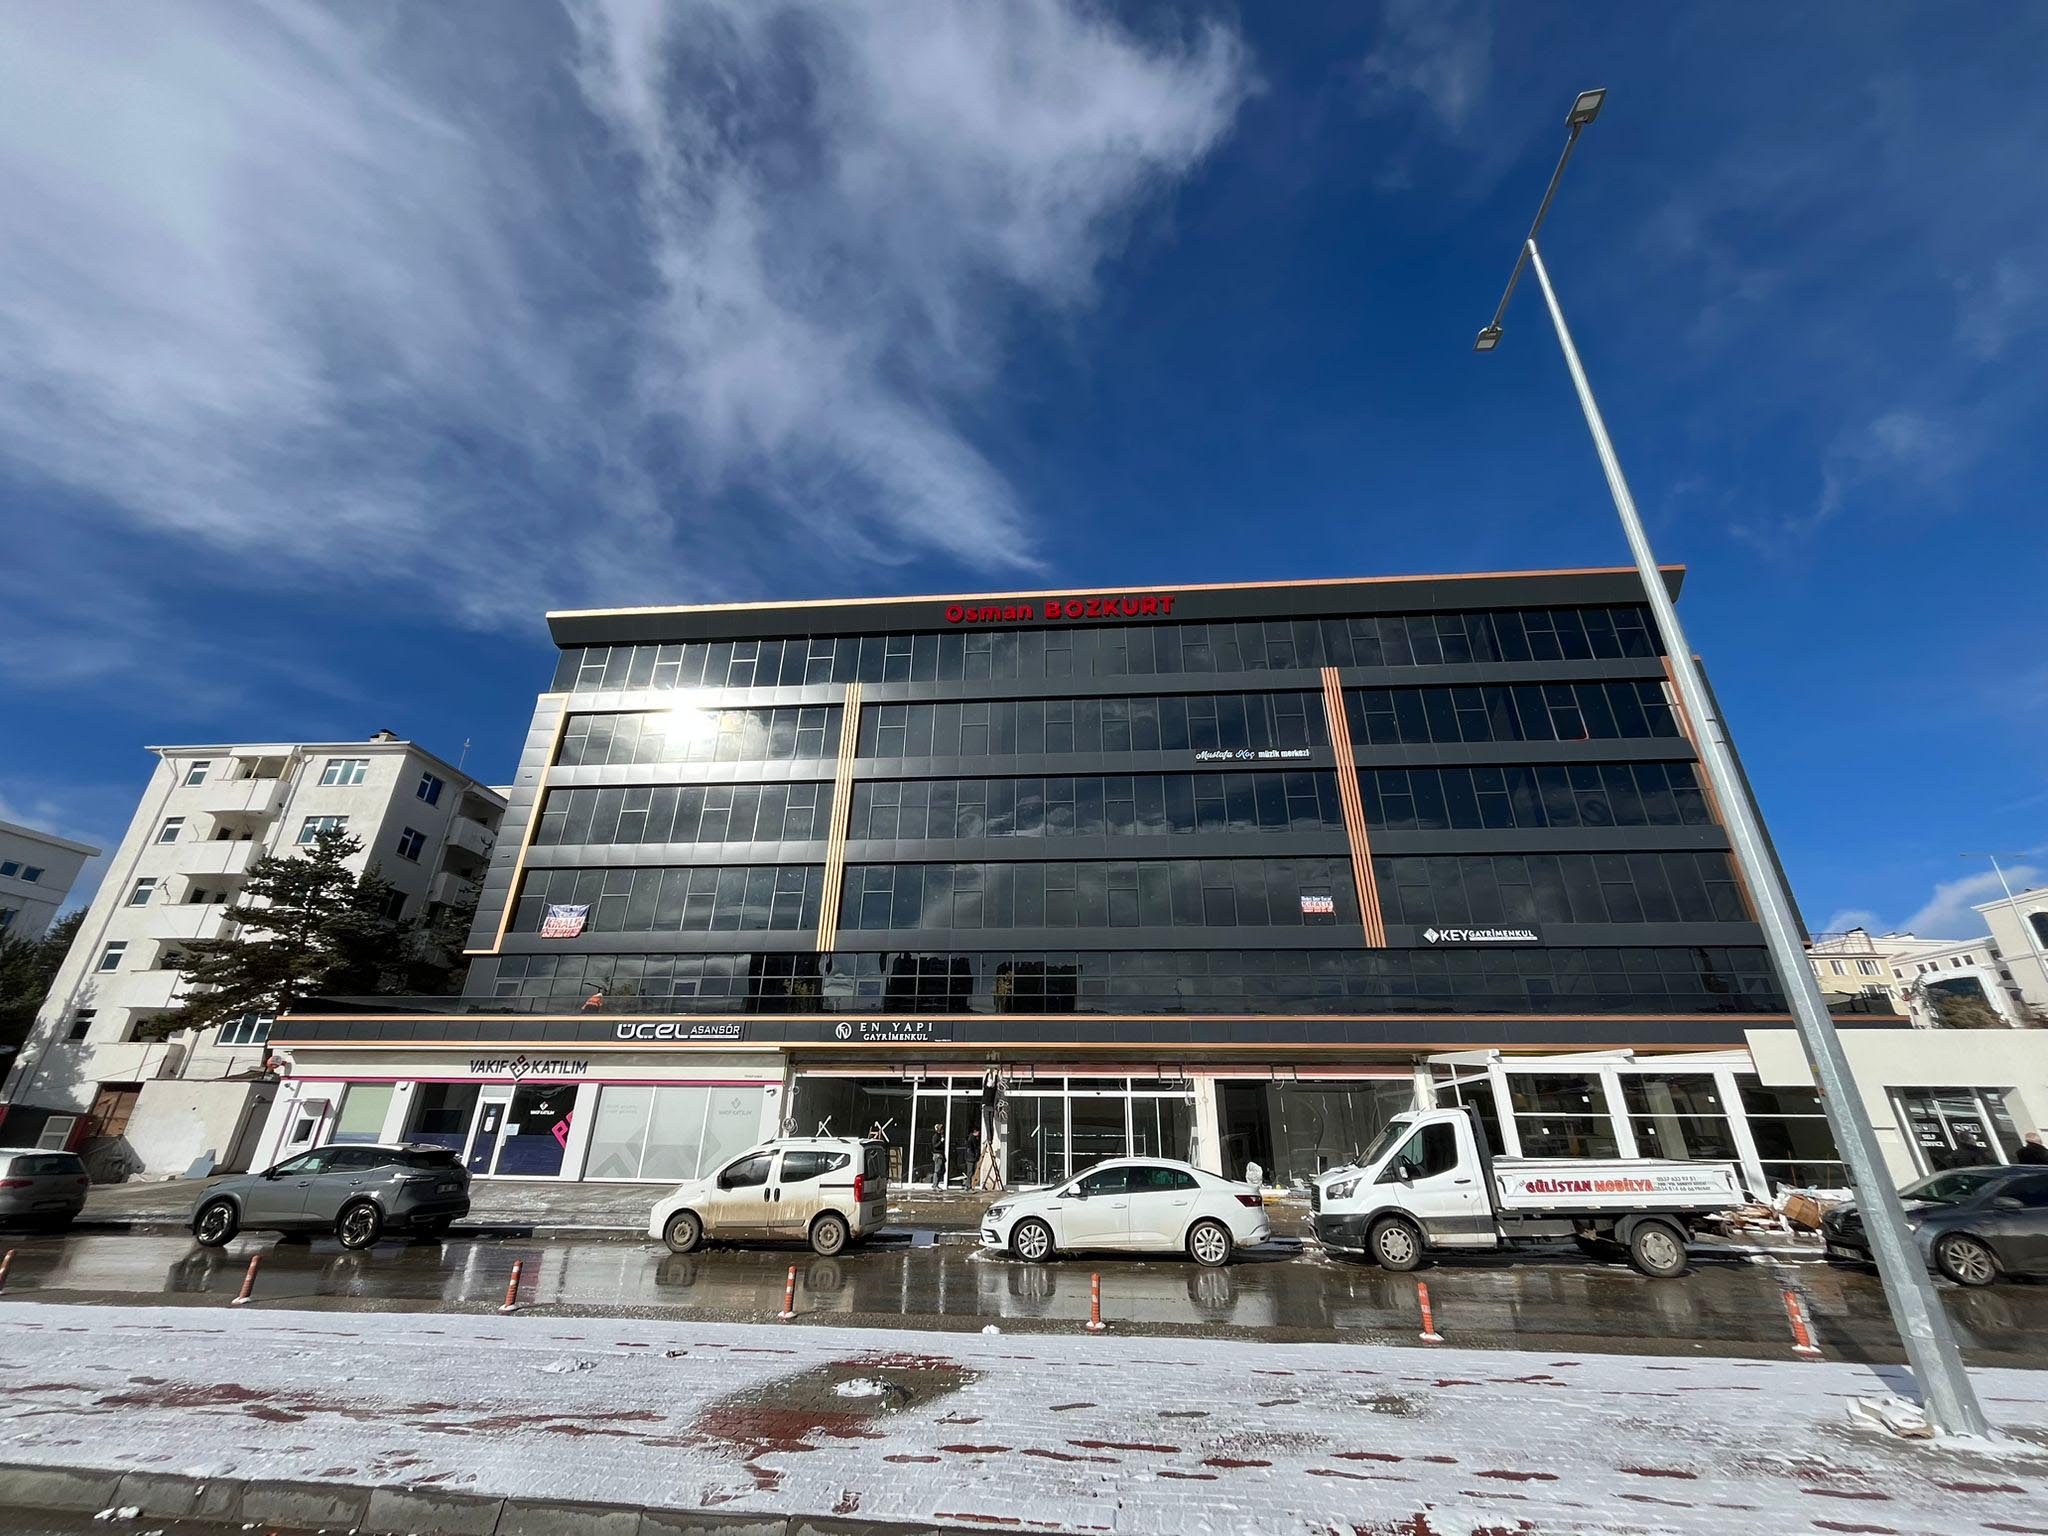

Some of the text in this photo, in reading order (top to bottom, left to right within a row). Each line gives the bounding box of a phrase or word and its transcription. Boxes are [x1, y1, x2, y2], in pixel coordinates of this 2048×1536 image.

[945, 595, 1176, 623] Osman BOZKURT
[1196, 748, 1310, 760] Mustafa Koç müzik merkezi
[1440, 928, 1534, 941] KEY GAYRİMENKUL
[860, 1022, 934, 1032] EN YAPI
[863, 1031, 929, 1041] GAYRİMENKUL
[470, 1060, 589, 1074] VAKIF KATILIM
[1525, 1178, 1593, 1193] GÜLİSTAN
[1594, 1177, 1655, 1192] MOBİLYA
